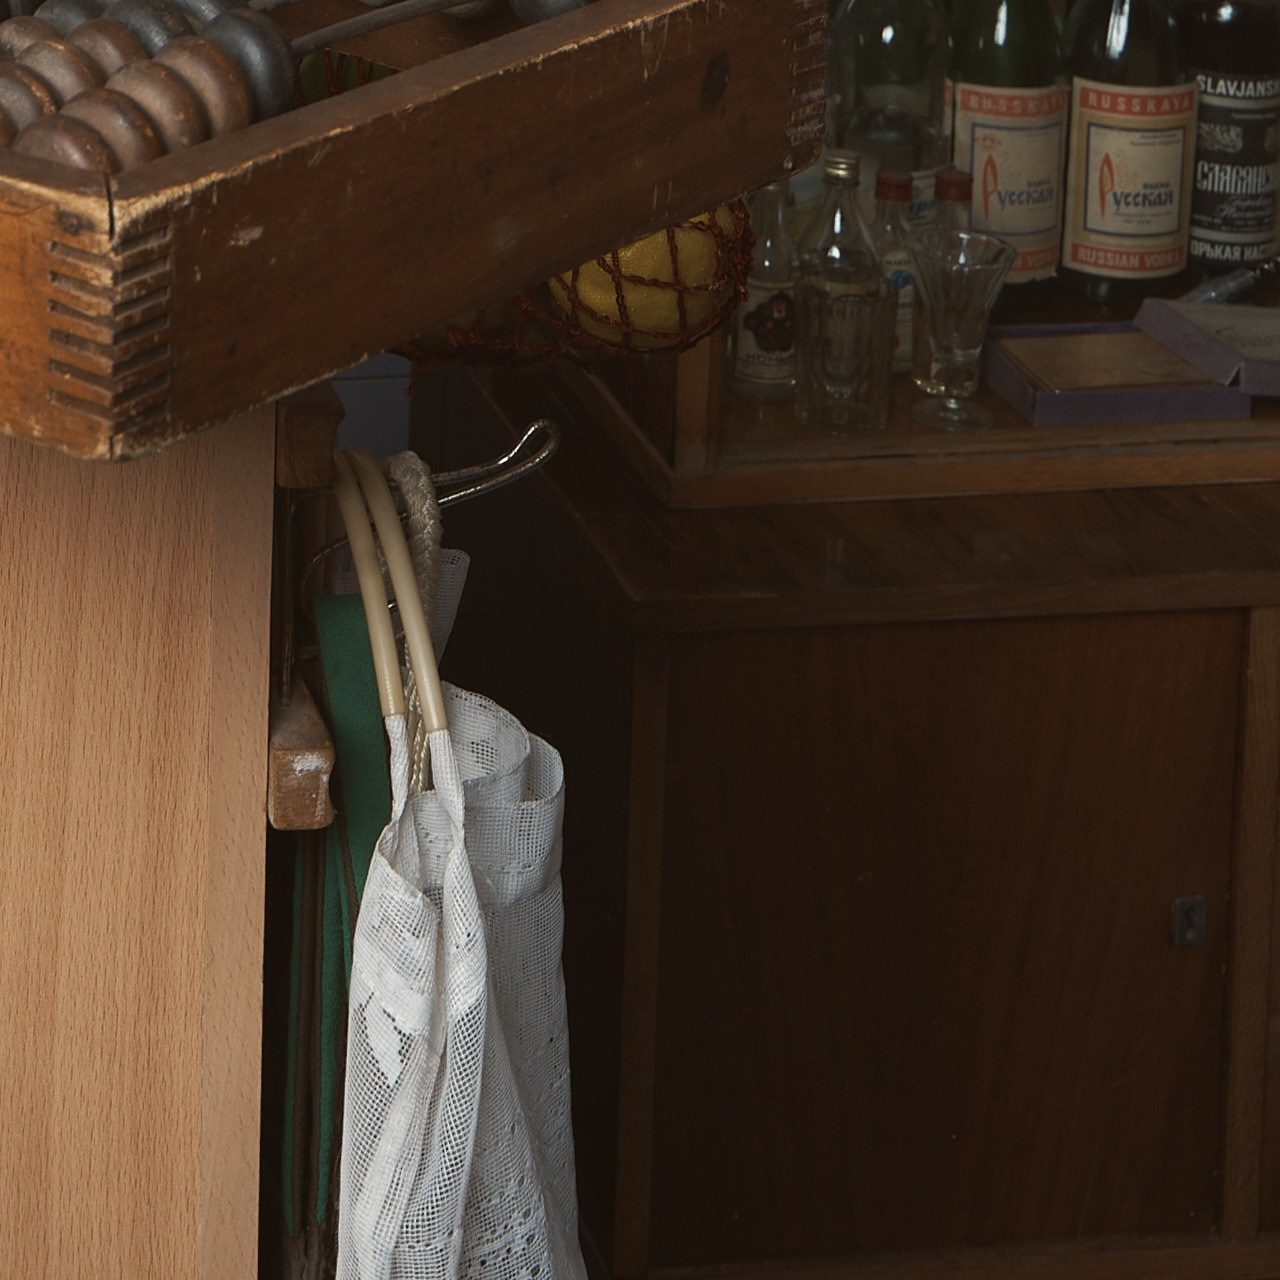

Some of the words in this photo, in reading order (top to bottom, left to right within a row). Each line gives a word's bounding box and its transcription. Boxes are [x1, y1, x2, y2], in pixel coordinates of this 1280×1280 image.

[1088, 91, 1191, 113] RUSSKAYA
[1098, 151, 1174, 220] Русская
[1077, 247, 1140, 268] RUSSIAN
